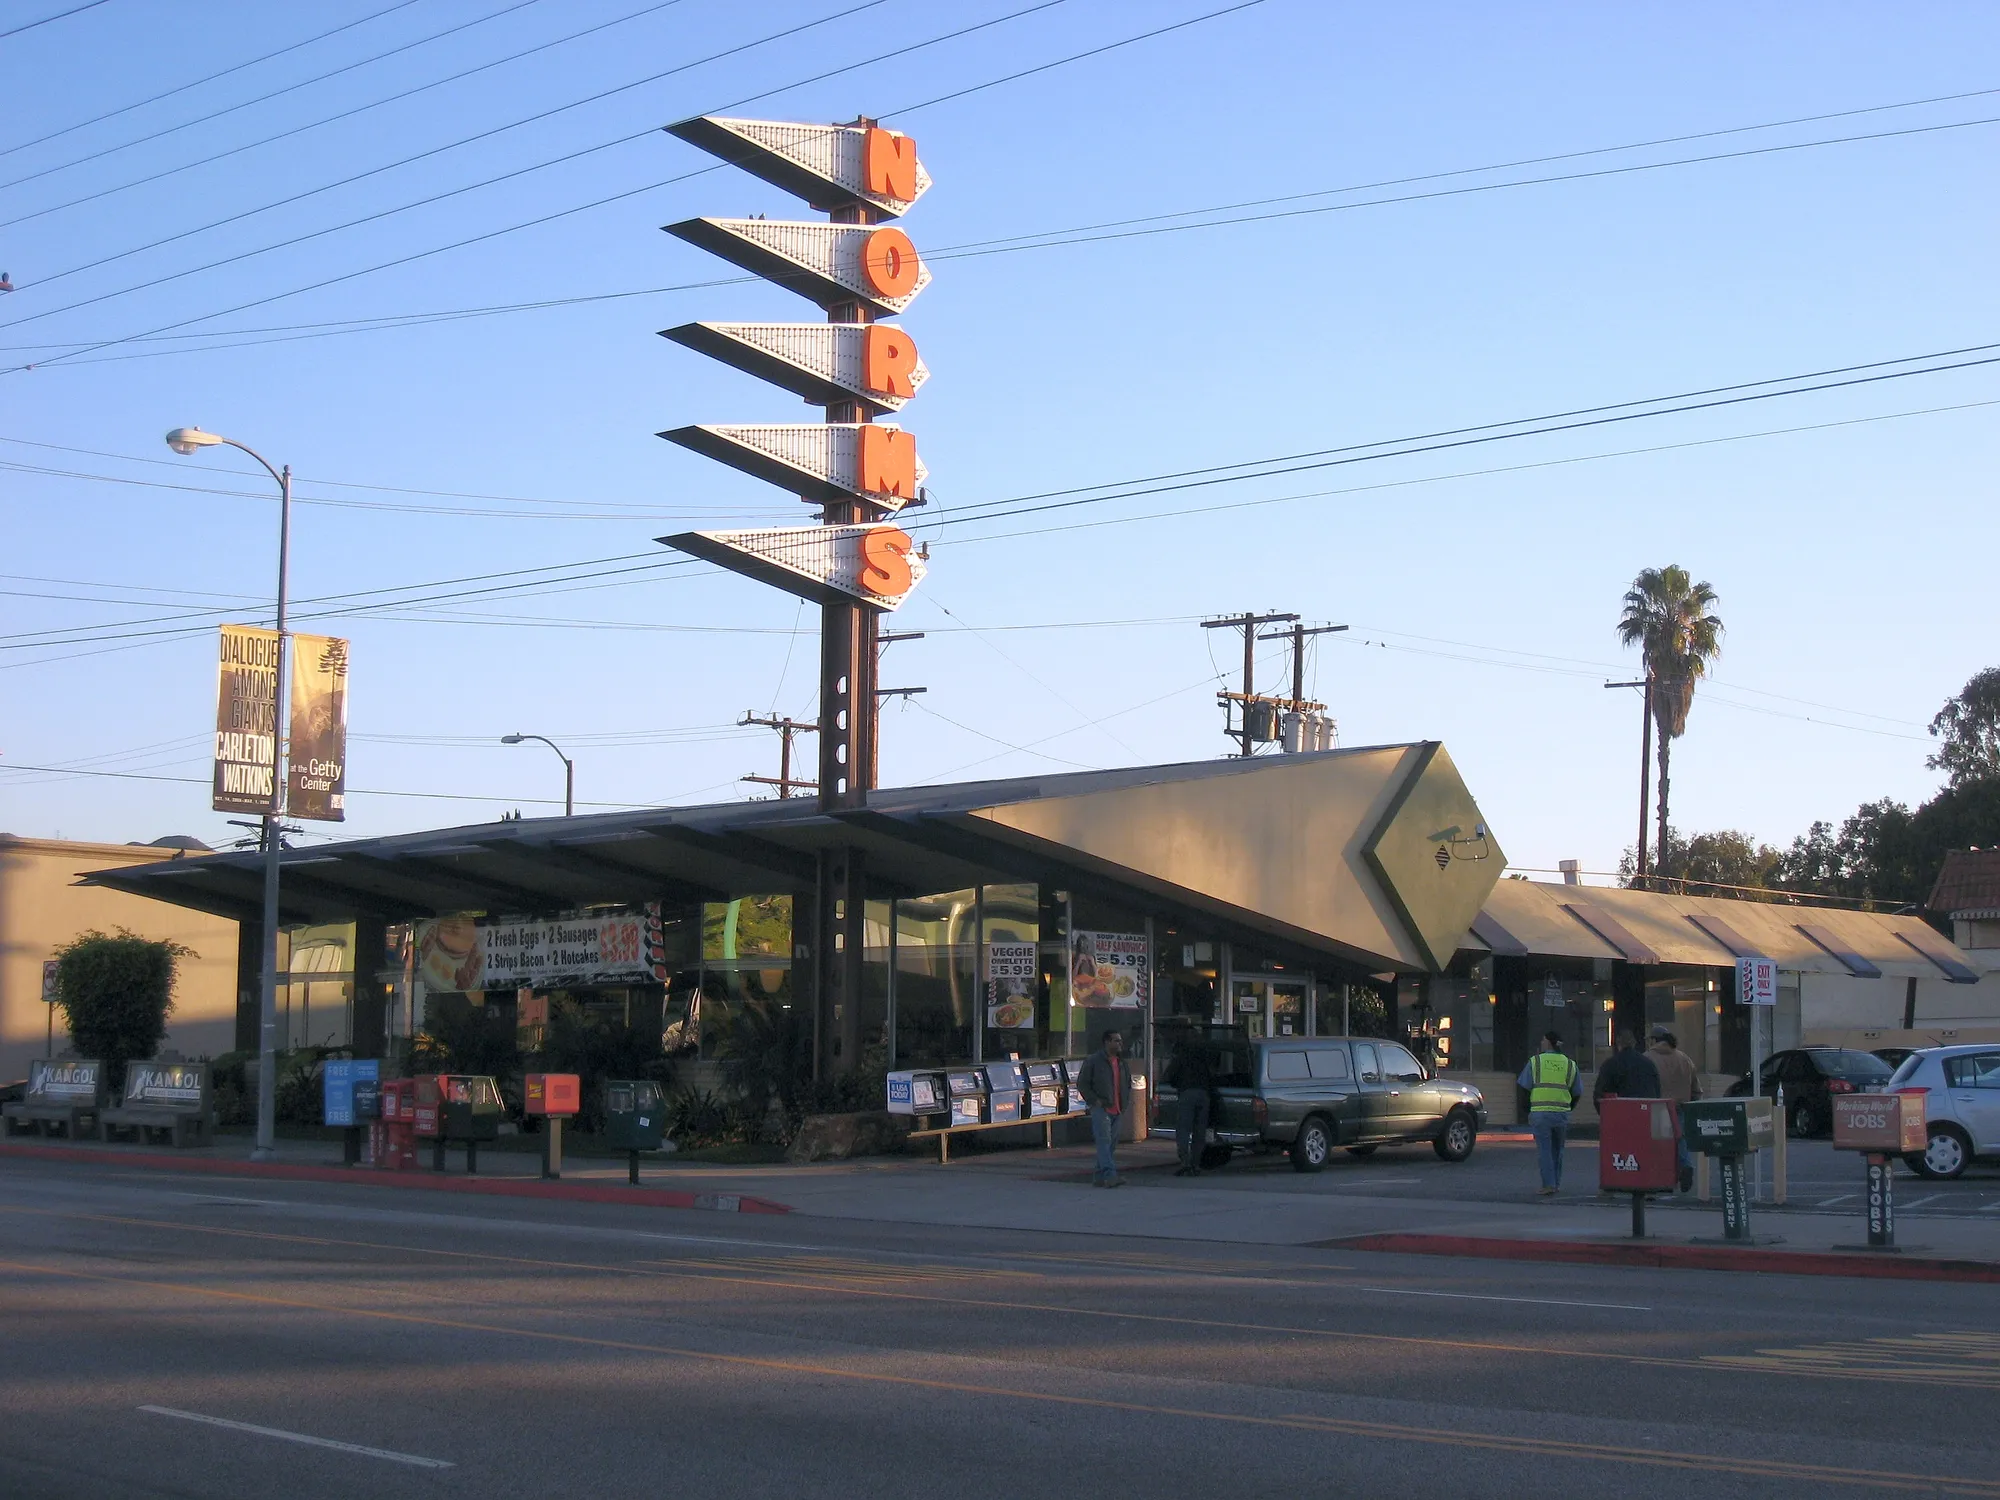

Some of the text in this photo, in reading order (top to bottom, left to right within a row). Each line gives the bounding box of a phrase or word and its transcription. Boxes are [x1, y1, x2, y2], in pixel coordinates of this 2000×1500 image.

[220, 634, 278, 668] DIALOGUE
[232, 668, 278, 700] AMONG
[231, 699, 276, 732] GIANTS
[215, 731, 275, 765] CARLETON
[290, 758, 342, 782] at the Getty
[223, 763, 274, 796] WATKINS
[301, 776, 332, 792] Center
[487, 925, 598, 949] 2 Fresh Eggs 2 Sausages
[487, 954, 493, 969] 2
[495, 952, 518, 971] Strips
[520, 951, 545, 968] Bacon
[553, 950, 559, 966] 2
[561, 948, 599, 965] Hotcakes
[992, 947, 1034, 957] VEGGIE
[1097, 953, 1147, 967] $5.99
[991, 965, 1034, 975] $5.99
[1757, 965, 1770, 978] EXIT
[46, 1067, 96, 1084] KANGOL
[327, 1065, 349, 1076] FREE
[145, 1071, 201, 1089] KANGOL
[896, 1084, 907, 1092] USA
[890, 1090, 909, 1099] TODAY
[1837, 1100, 1870, 1113] Working
[1870, 1101, 1894, 1112] World
[328, 1111, 350, 1121] FREE
[1848, 1114, 1886, 1129] JOBS
[1904, 1116, 1921, 1127] JOBS
[1612, 1153, 1640, 1167] LA
[1723, 1164, 1735, 1228] EMPLOYMENT
[1737, 1163, 1748, 1228] EMPLOYMENT
[1869, 1179, 1882, 1233] JOBS
[1885, 1179, 1893, 1233] JOBS
